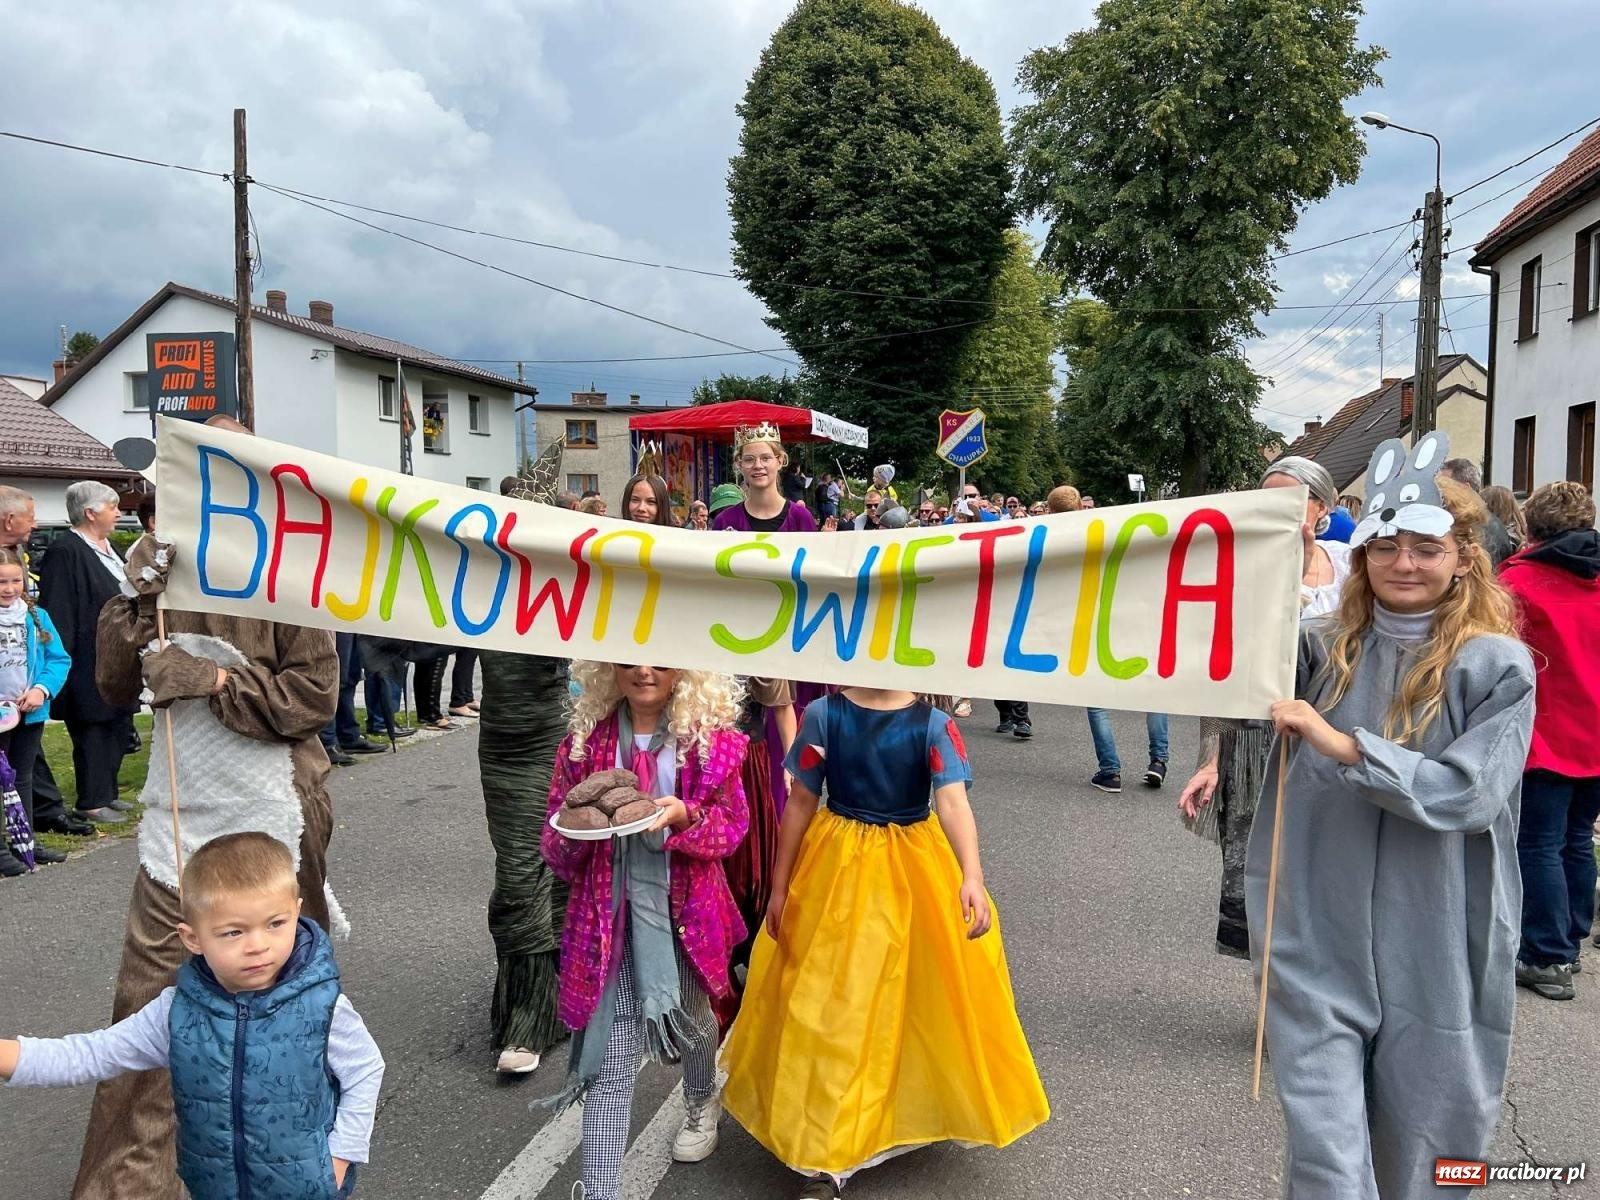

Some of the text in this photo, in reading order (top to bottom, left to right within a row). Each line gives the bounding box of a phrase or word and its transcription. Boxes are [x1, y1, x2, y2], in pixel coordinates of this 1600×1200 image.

[159, 344, 197, 361] PROFI
[203, 340, 216, 389] SERWIS
[162, 372, 196, 390] AUTO
[157, 395, 217, 412] PROFIAUTO
[946, 418, 958, 426] KS
[197, 446, 1235, 682] BAJKOWA ŚWIETLICA
